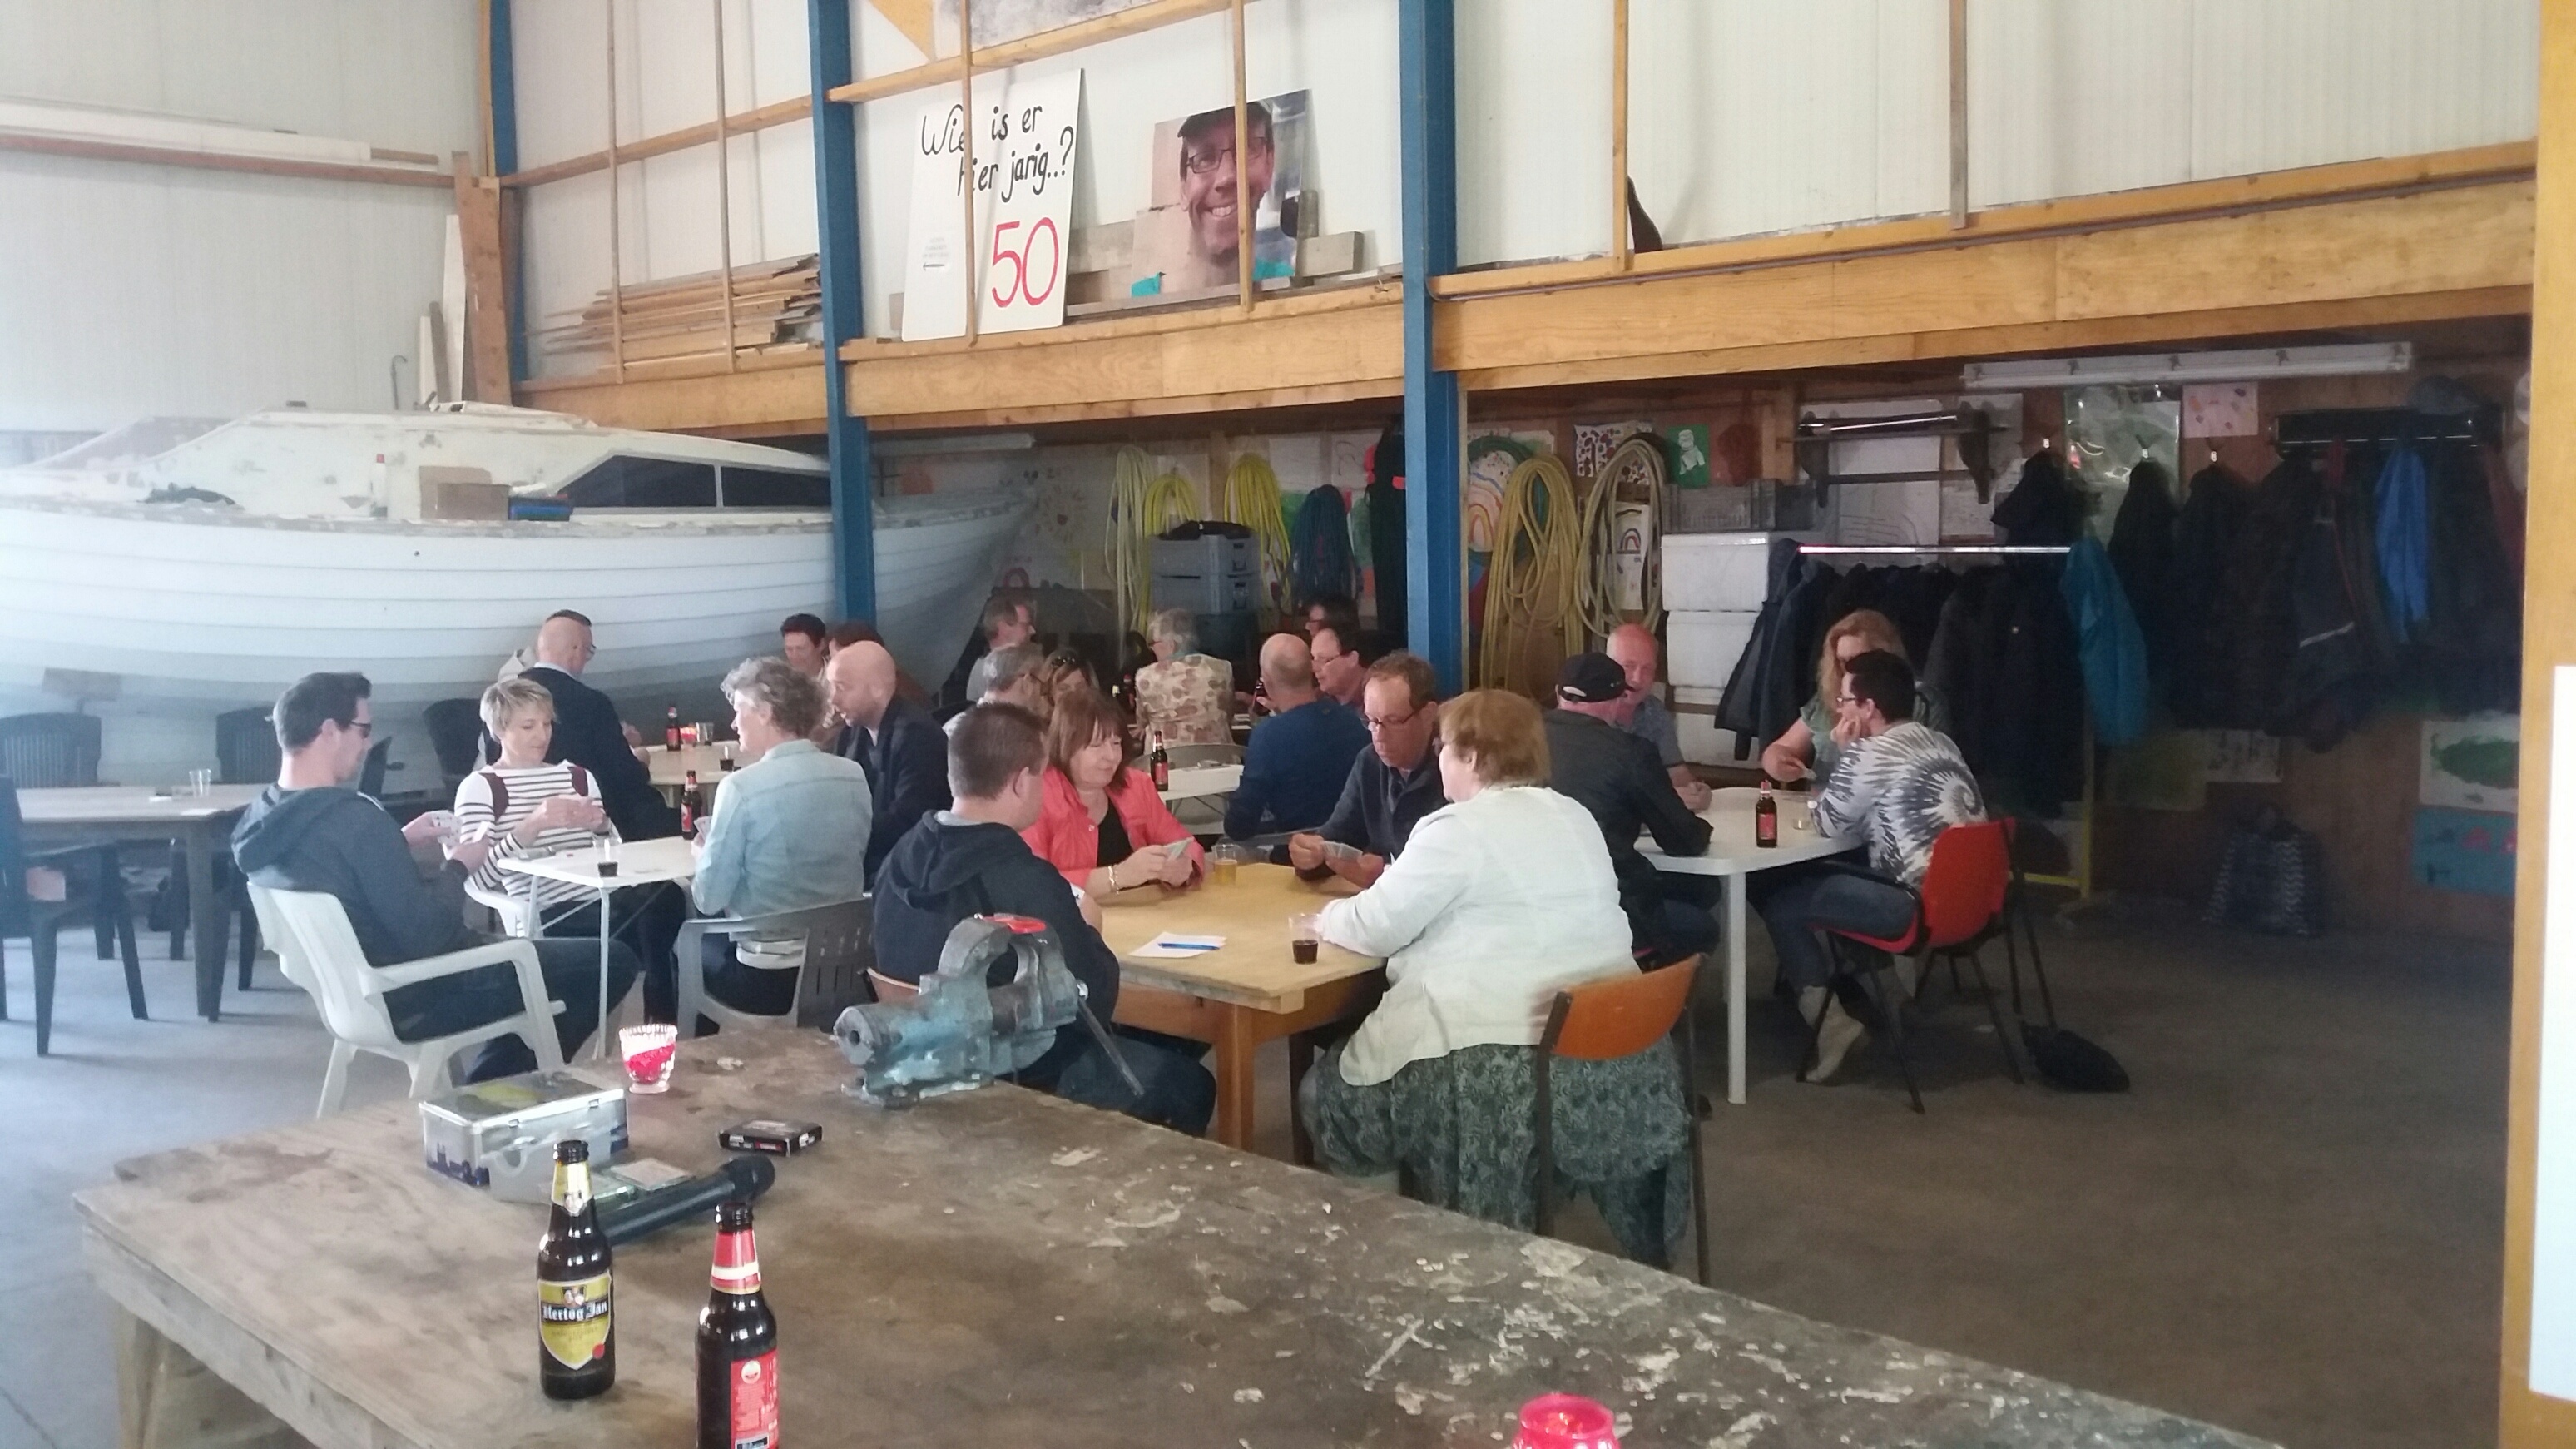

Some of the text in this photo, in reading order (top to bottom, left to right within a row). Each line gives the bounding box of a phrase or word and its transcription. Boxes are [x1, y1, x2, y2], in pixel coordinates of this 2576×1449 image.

[921, 103, 1043, 156] Wie is er
[991, 216, 1059, 308] 50
[542, 1300, 607, 1322] Hertog Jan
